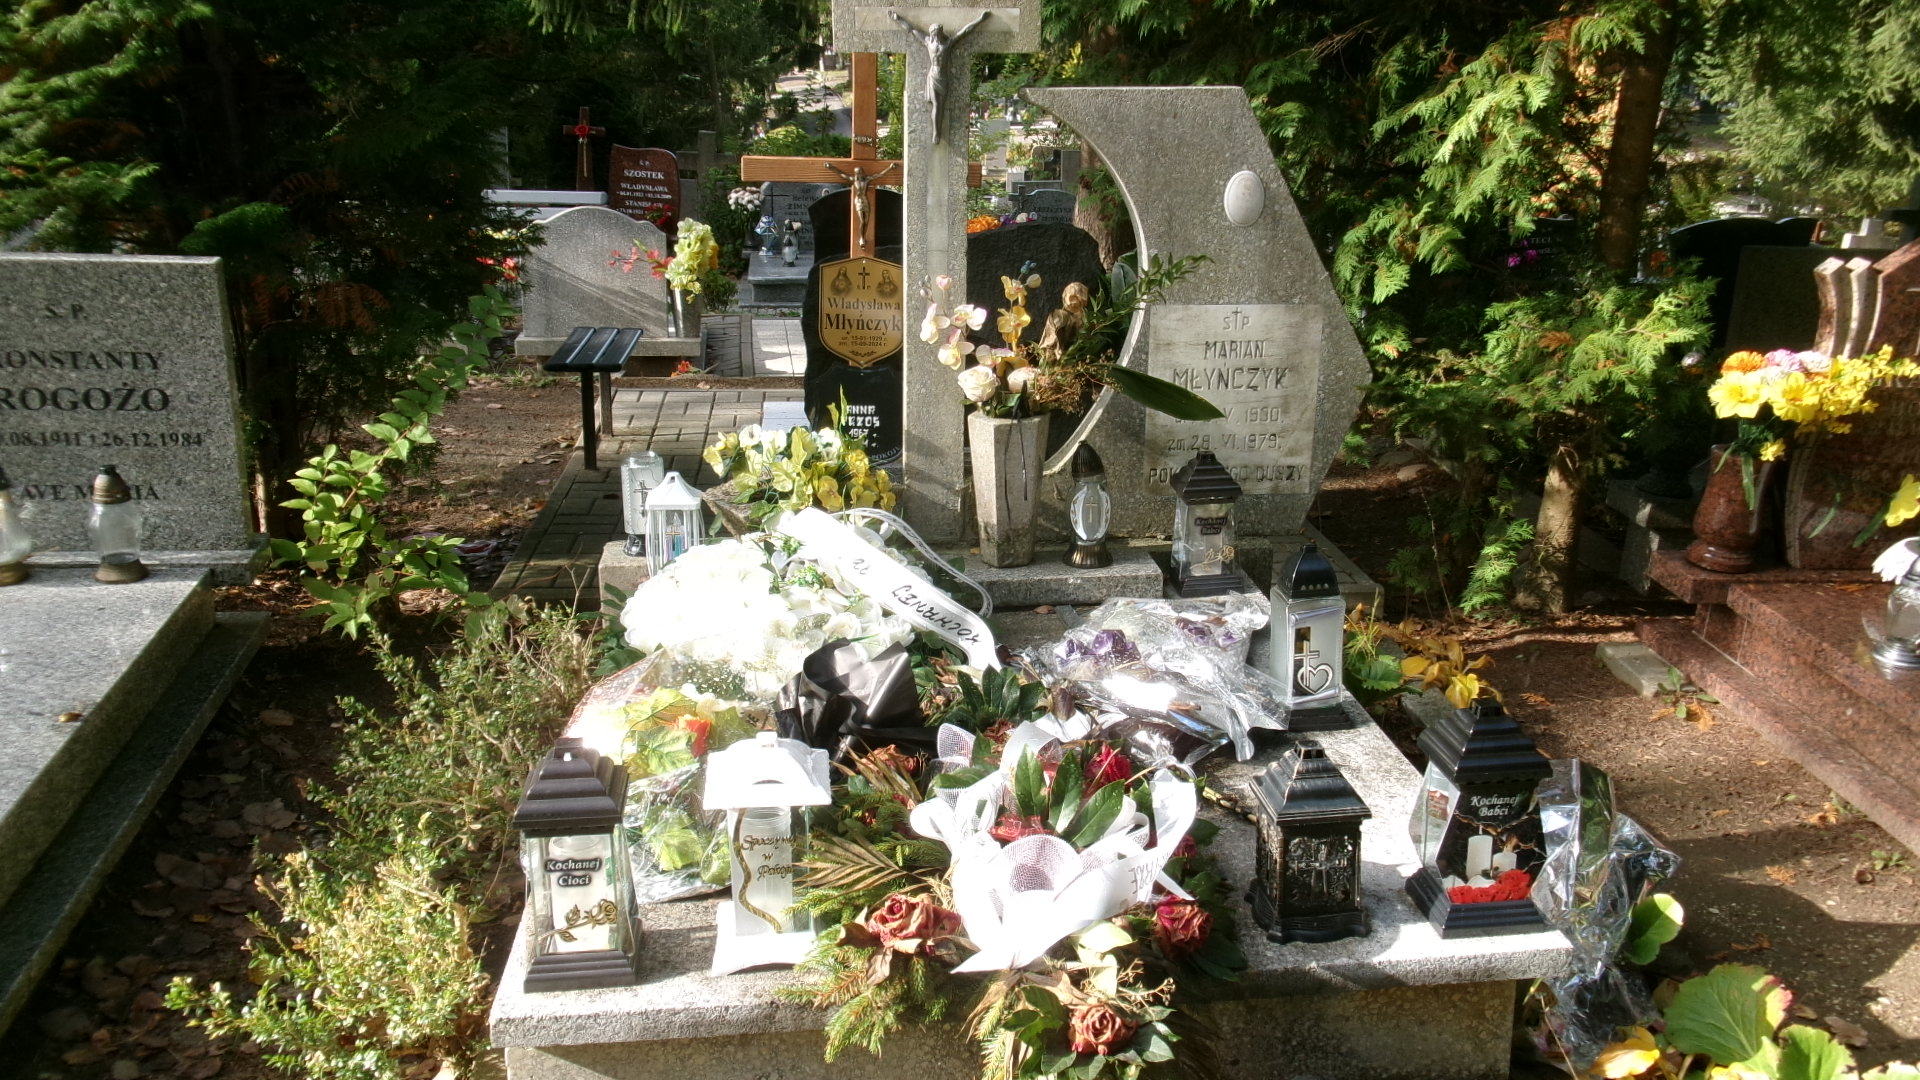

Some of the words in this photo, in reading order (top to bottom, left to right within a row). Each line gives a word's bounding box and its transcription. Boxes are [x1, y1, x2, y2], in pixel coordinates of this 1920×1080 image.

[623, 168, 665, 180] SZOSTEK
[620, 182, 669, 193] WŁADYSŁAWA
[827, 297, 901, 313] Władysława
[824, 311, 903, 336] Młyńczyk
[1203, 340, 1267, 360] MARIAN
[0, 350, 162, 370] ONSTANTY
[1172, 363, 1289, 391] MŁYŃCZYK
[1255, 464, 1306, 483] DUSZY
[19, 484, 67, 500] AVE
[1470, 793, 1520, 807] Kochanej
[1479, 805, 1509, 817] Babci
[546, 858, 600, 871] Kochanej
[558, 874, 591, 886] Cioci
